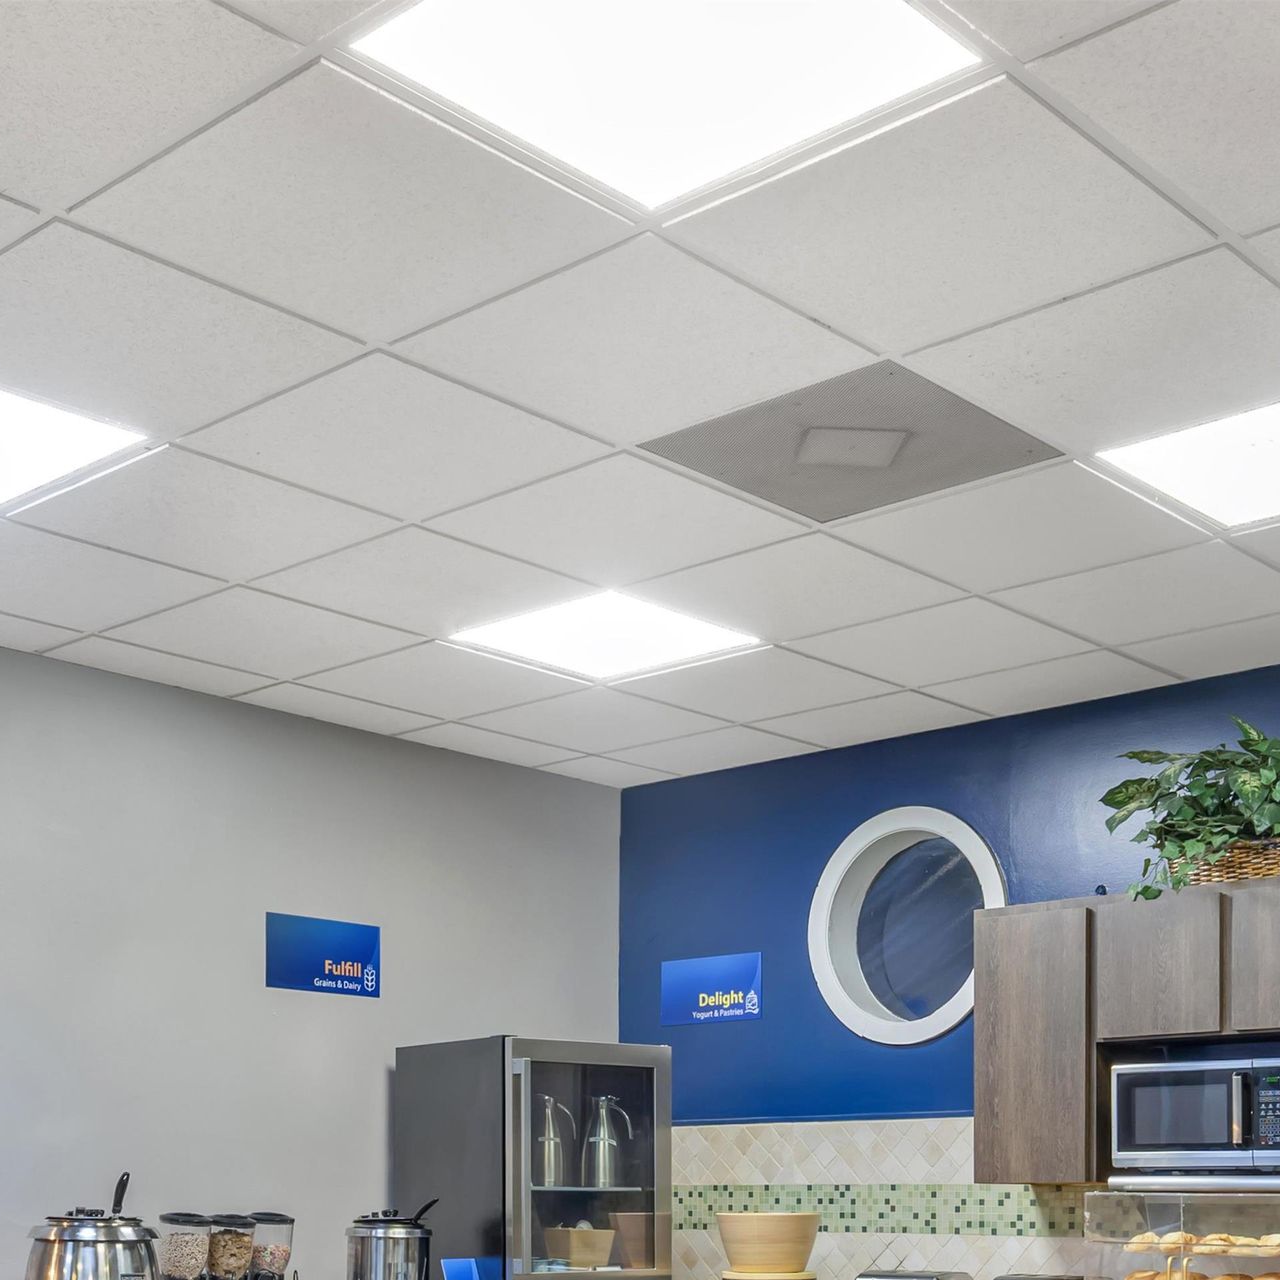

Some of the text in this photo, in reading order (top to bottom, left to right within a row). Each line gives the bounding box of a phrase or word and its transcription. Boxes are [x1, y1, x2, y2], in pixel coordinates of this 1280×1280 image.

[324, 959, 362, 977] Fulfill
[313, 977, 336, 989] Grains
[343, 980, 362, 992] Dairy
[699, 990, 744, 1008] Delight
[692, 1010, 713, 1020] Yogurt
[719, 1008, 744, 1017] Pastries
